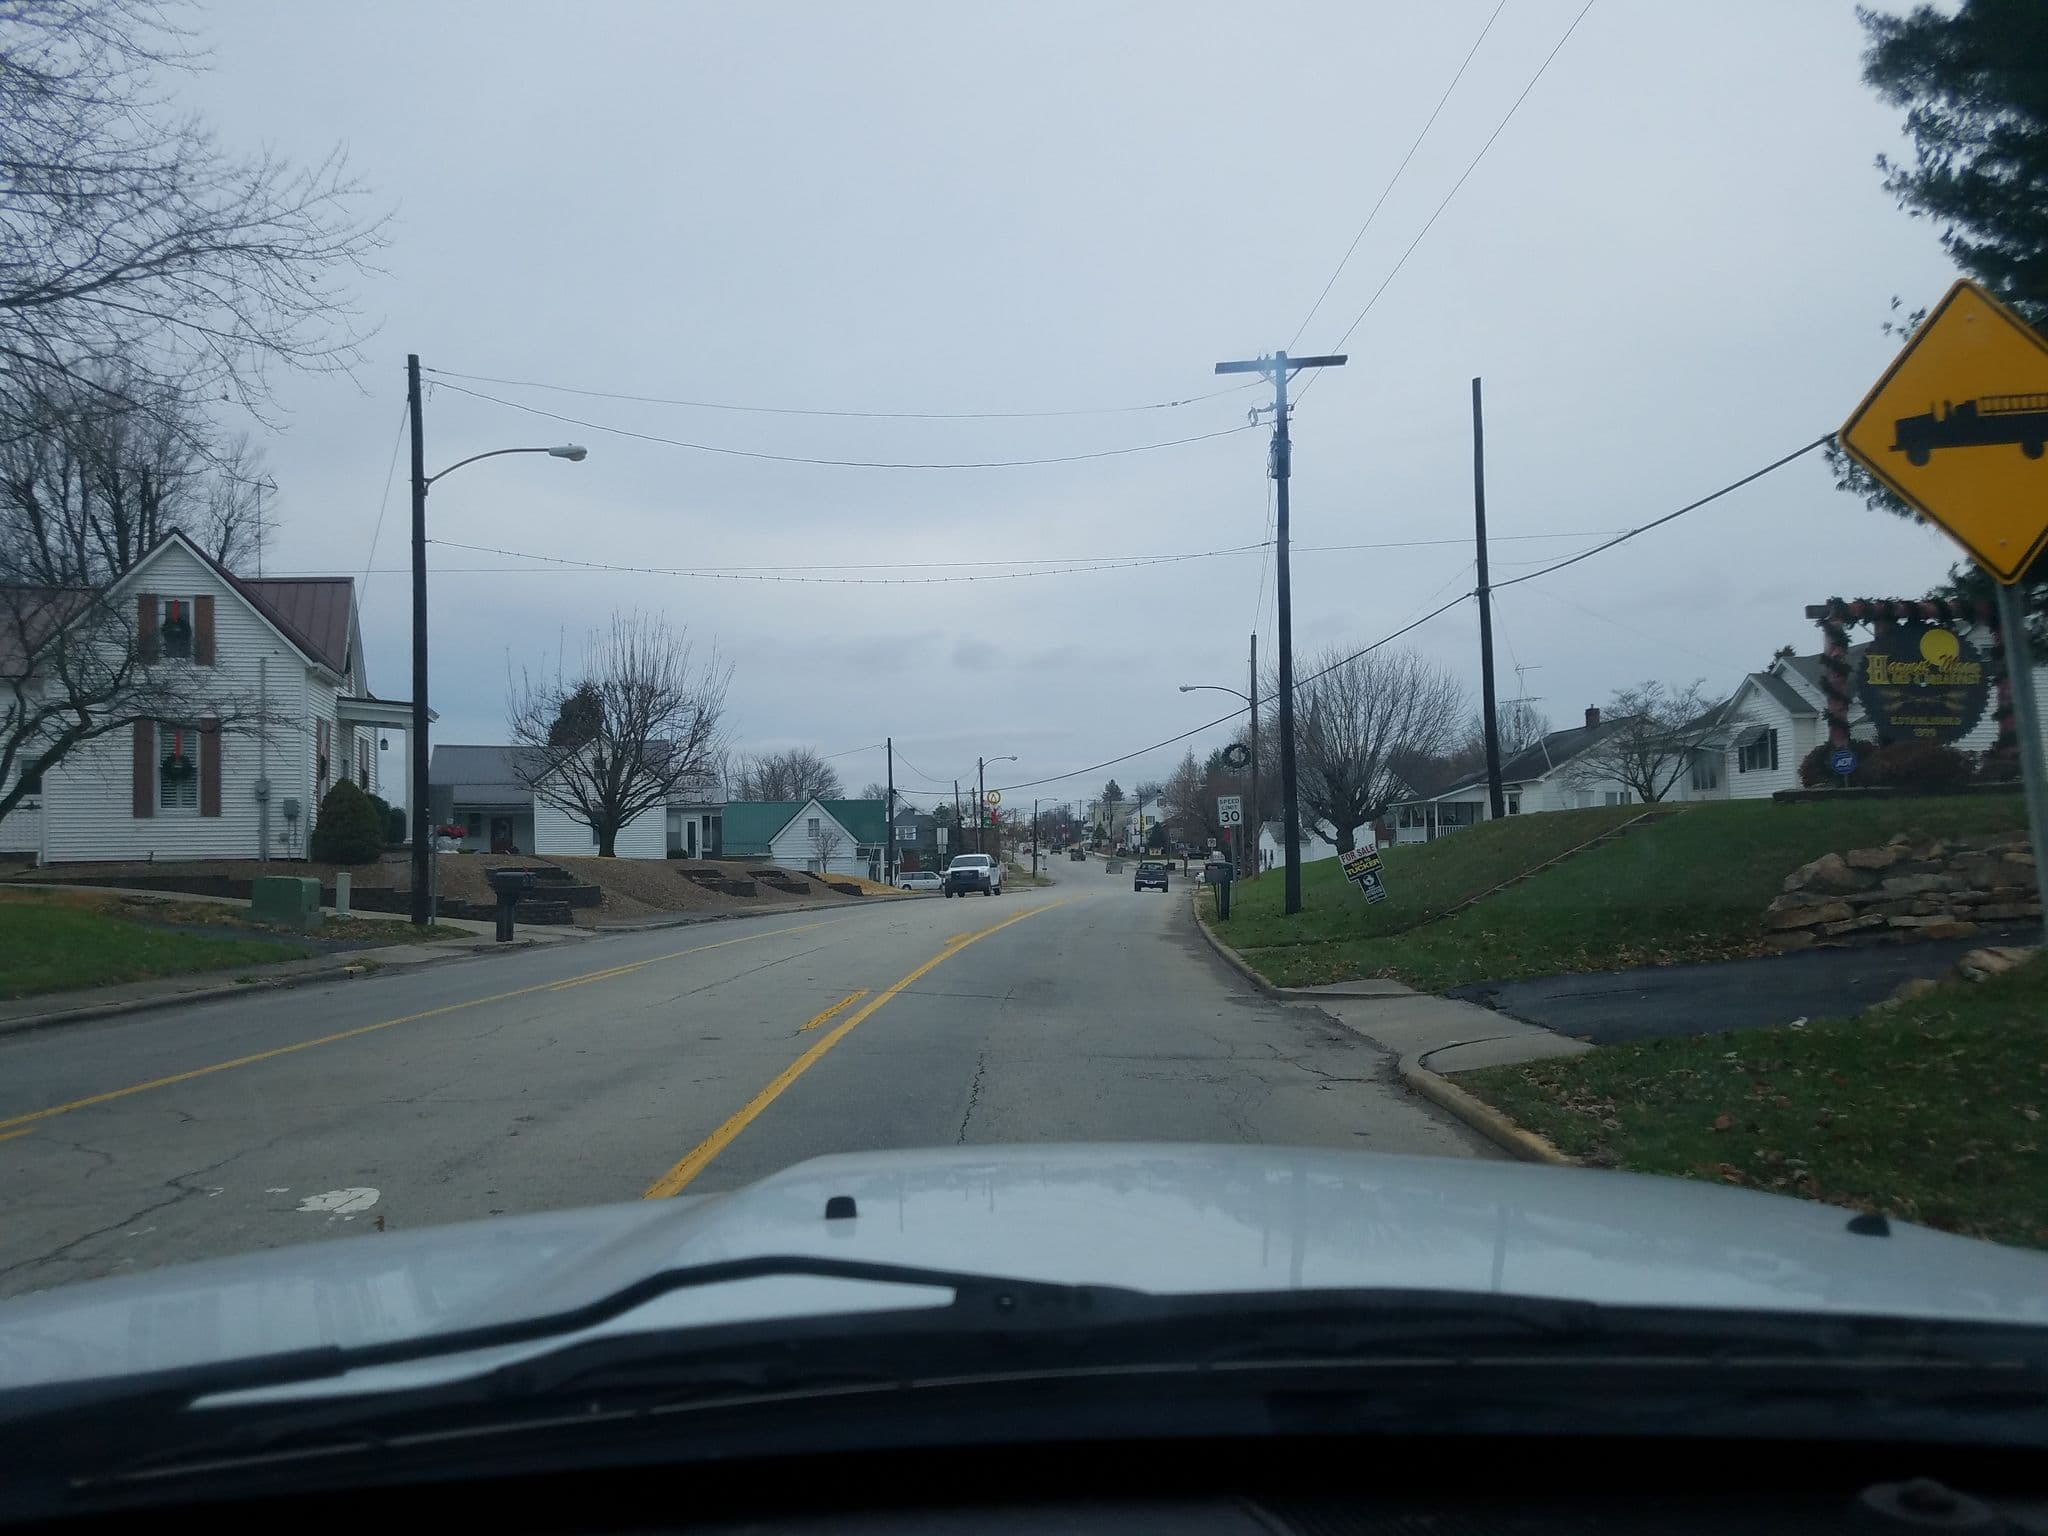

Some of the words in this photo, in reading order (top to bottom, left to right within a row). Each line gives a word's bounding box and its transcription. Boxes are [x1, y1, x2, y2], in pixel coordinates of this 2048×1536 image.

[1221, 811, 1240, 822] 30
[1341, 851, 1357, 863] FOR
[1357, 843, 1375, 857] SALE
[1346, 859, 1379, 875] TUCKER
